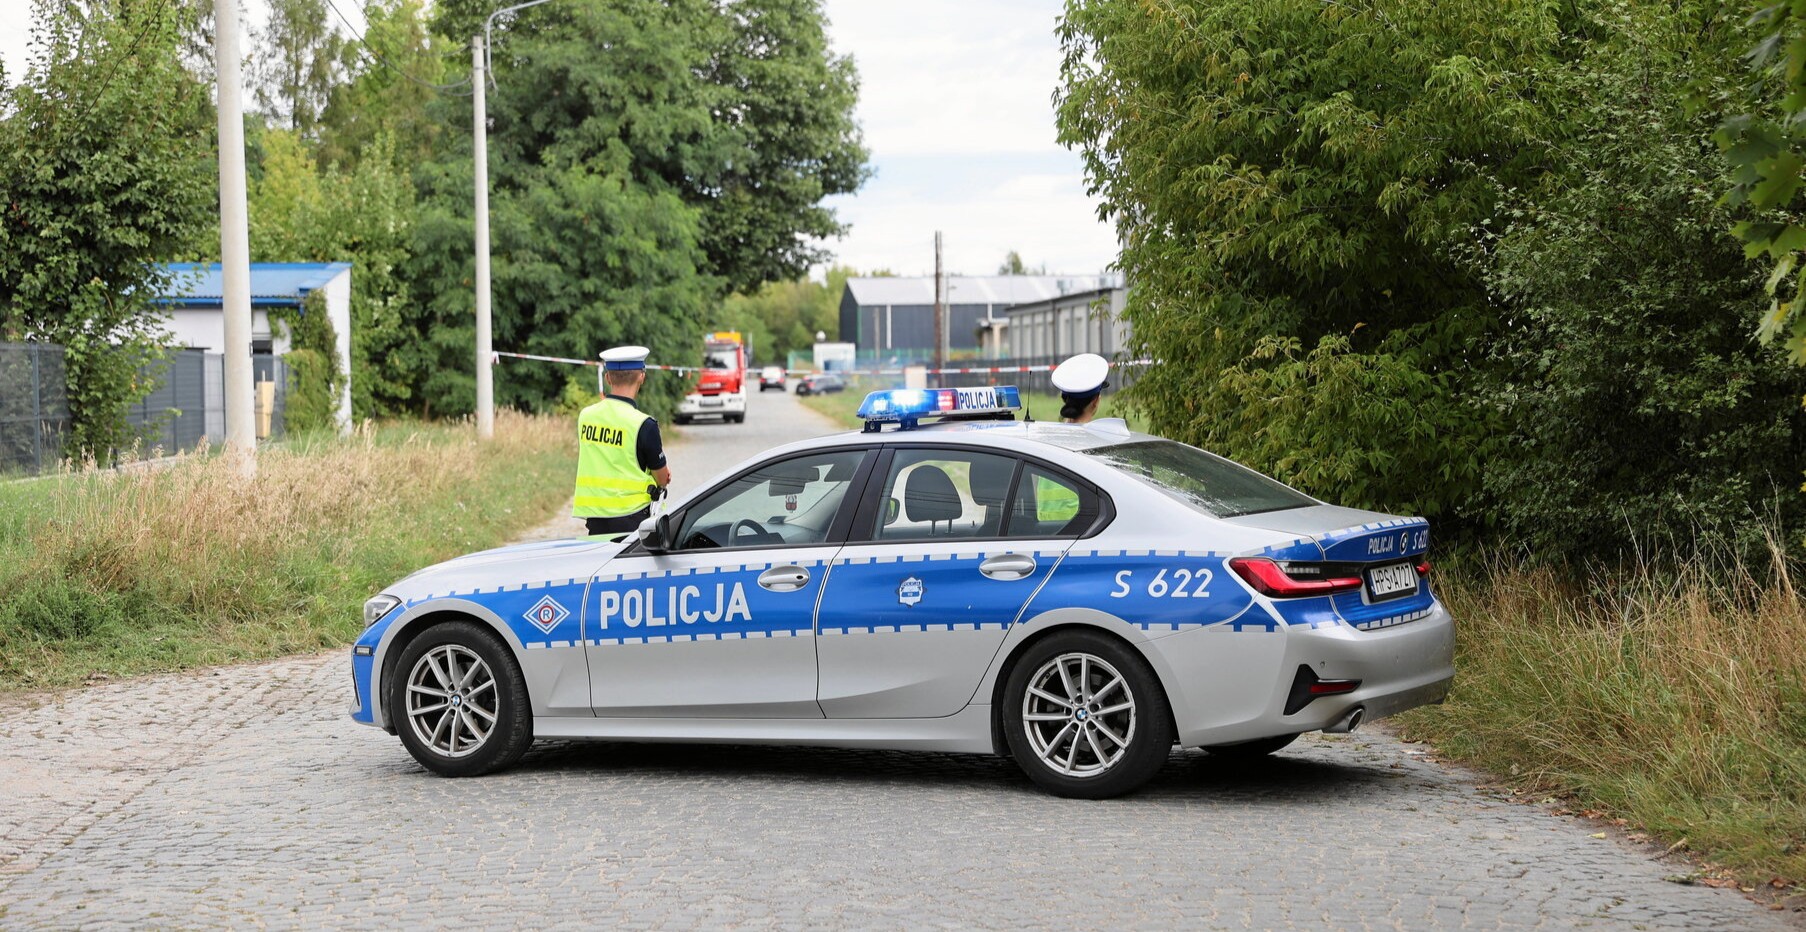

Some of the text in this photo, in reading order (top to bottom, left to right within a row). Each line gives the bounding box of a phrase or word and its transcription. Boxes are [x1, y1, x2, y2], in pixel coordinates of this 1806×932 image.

[959, 389, 996, 409] POLICJA
[581, 424, 623, 447] POLICJA
[1368, 535, 1394, 555] POLICJA
[1412, 532, 1419, 550] S
[1110, 568, 1213, 598] S 622
[542, 609, 551, 619] R
[600, 582, 752, 630] POLICJA
